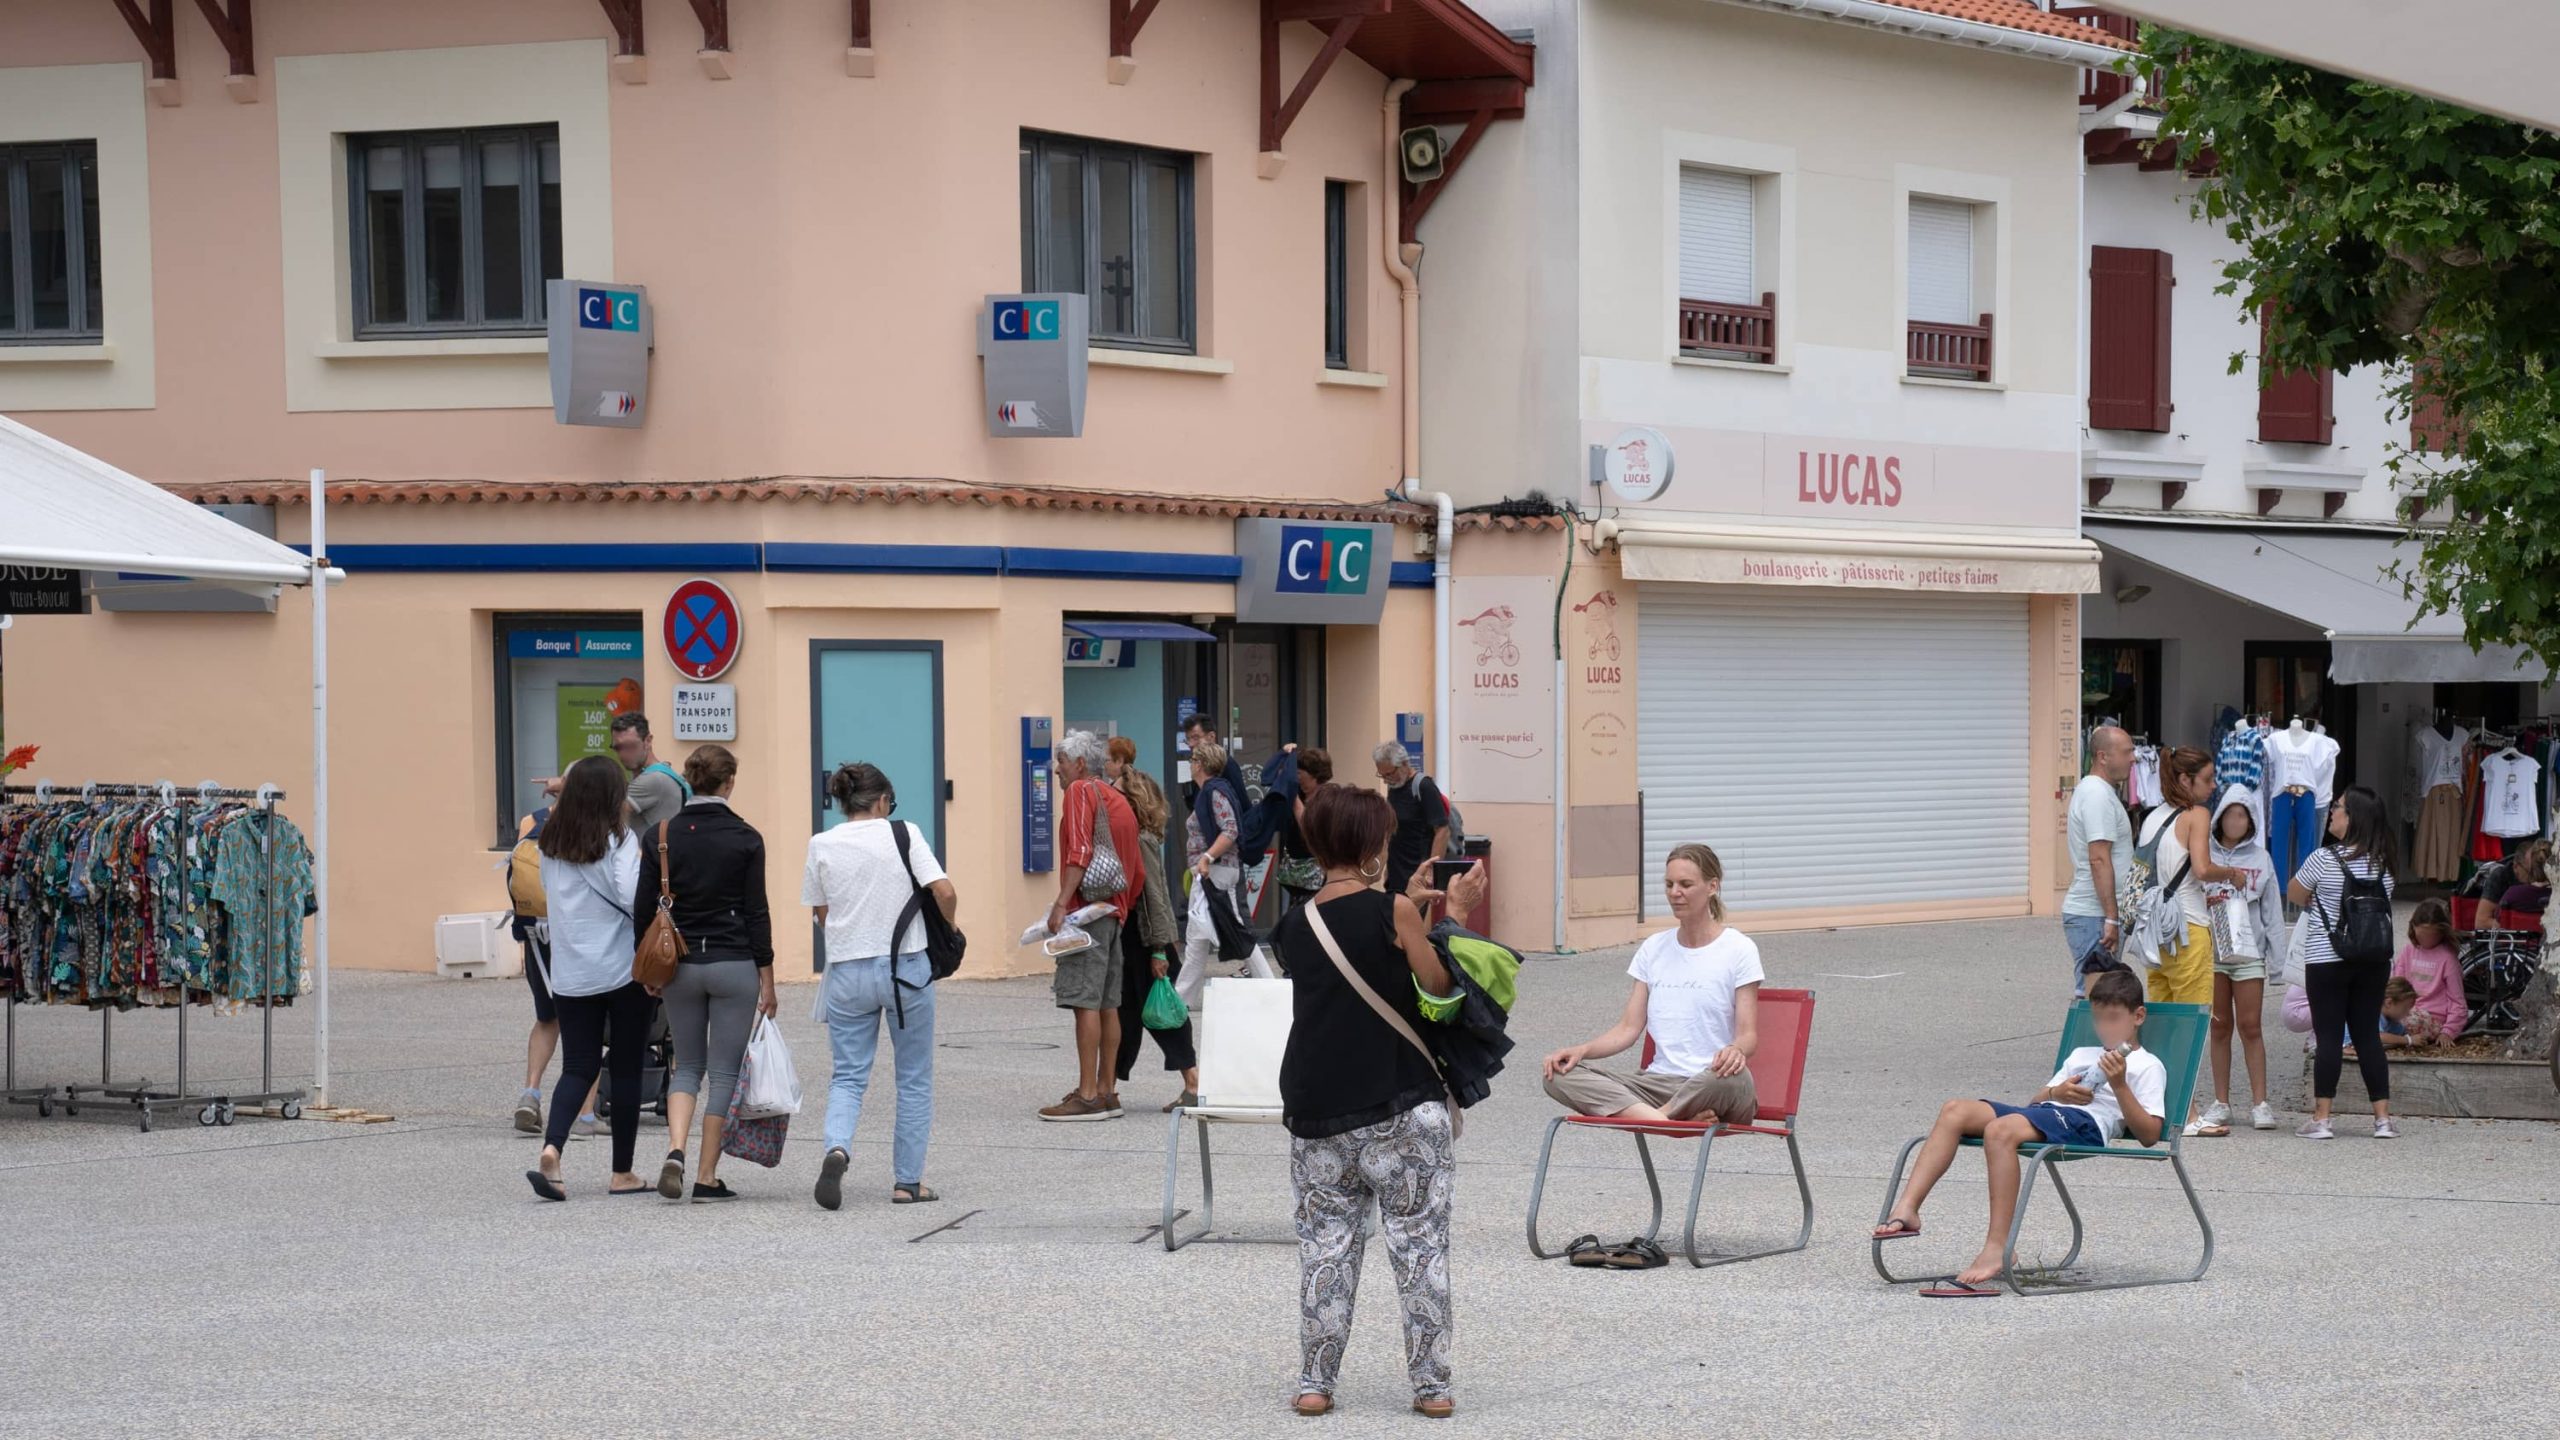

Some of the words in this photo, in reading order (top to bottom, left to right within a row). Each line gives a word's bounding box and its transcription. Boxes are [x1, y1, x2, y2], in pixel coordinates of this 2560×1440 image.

[584, 296, 633, 325] CIC
[999, 308, 1053, 333] CIC
[1623, 473, 1651, 484] LUCAS
[1798, 451, 1902, 507] LUCAS
[1287, 538, 1364, 582] CIC
[1743, 558, 1829, 580] boulangerie
[1842, 562, 1905, 584] pâtisserie
[1918, 566, 1962, 587] petites
[1965, 567, 1999, 585] faims
[535, 639, 571, 653] Banque
[585, 639, 632, 651] Assurance
[1071, 641, 1100, 657] CIC
[1474, 672, 1519, 688] LUCAS
[1586, 666, 1621, 683] LUCAS
[691, 692, 716, 701] SAUF
[676, 708, 731, 717] TRANSPORT
[680, 723, 692, 732] DE
[696, 723, 728, 732] FONDS
[1481, 734, 1506, 743] passe
[1506, 734, 1521, 743] par
[1522, 732, 1534, 742] ici
